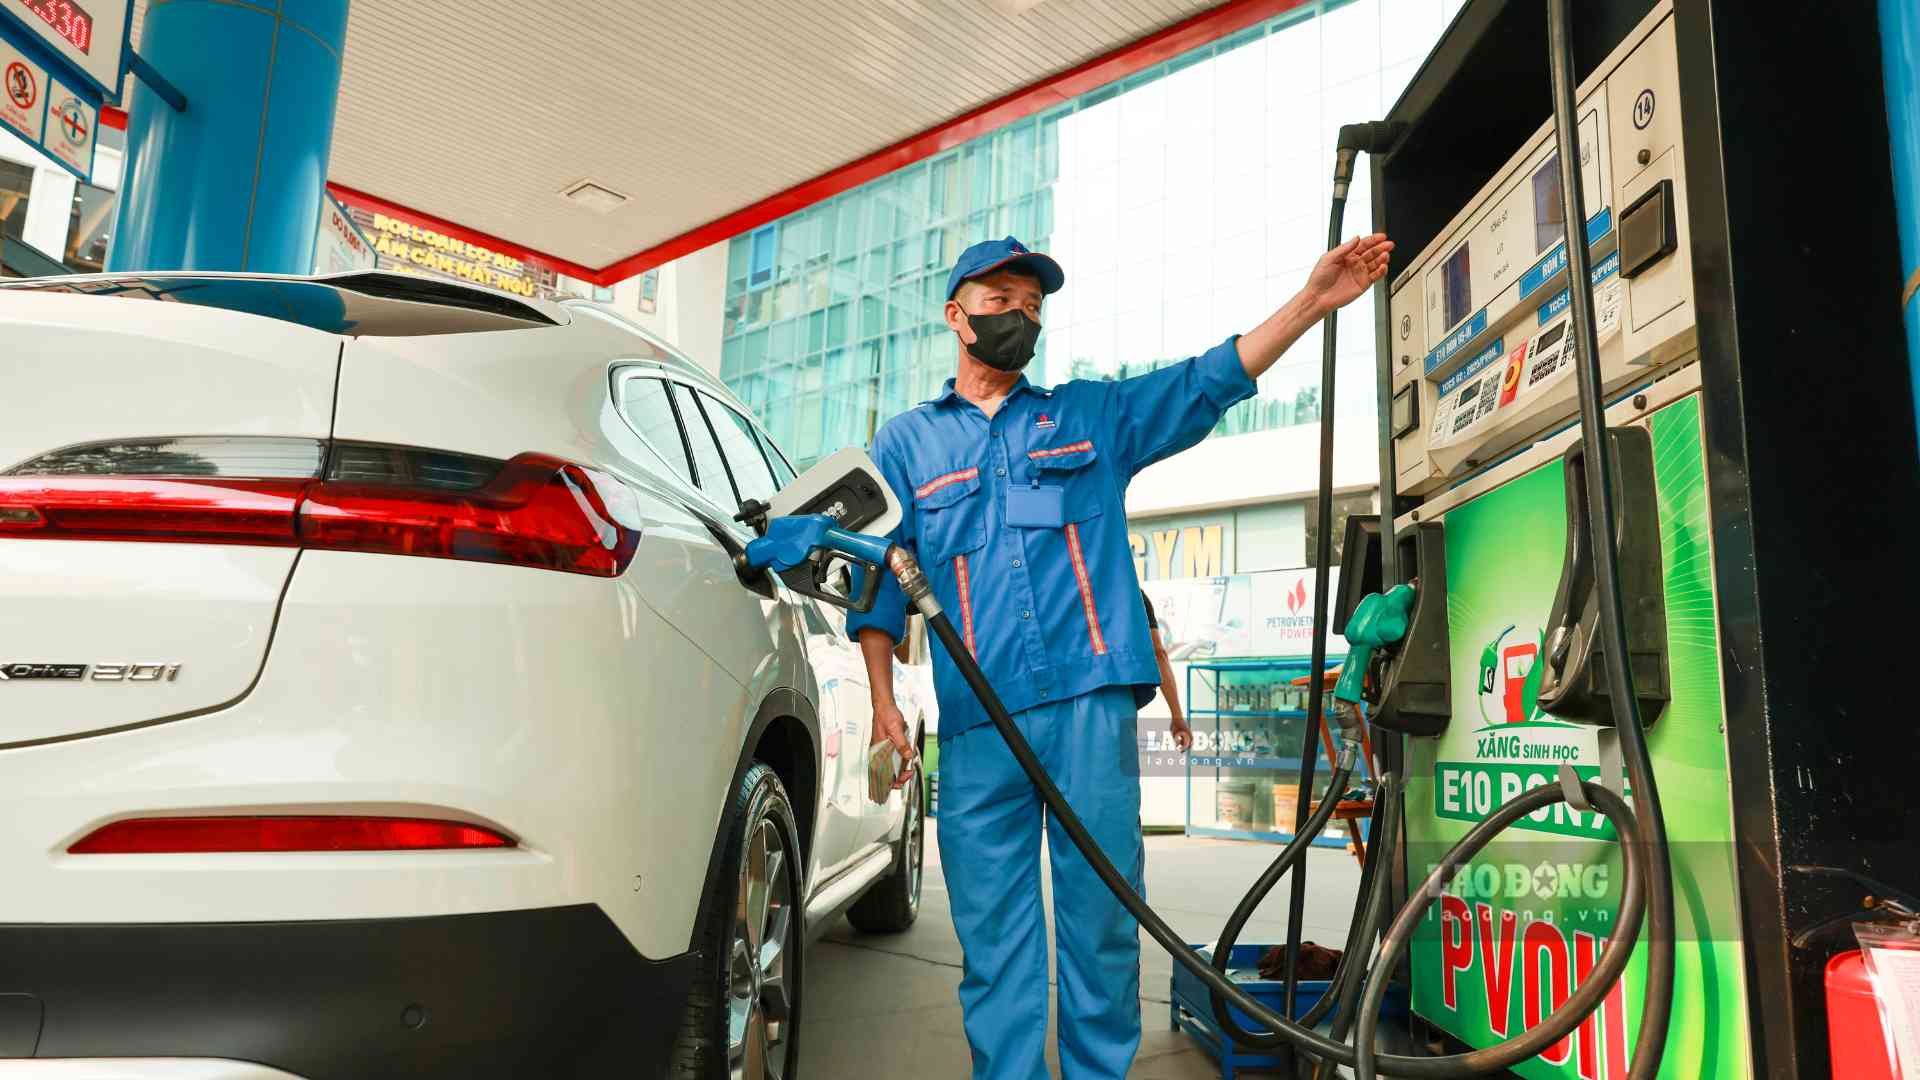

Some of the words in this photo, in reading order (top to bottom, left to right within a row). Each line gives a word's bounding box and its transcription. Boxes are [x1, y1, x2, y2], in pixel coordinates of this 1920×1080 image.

[1637, 95, 1651, 122] 14
[1128, 525, 1223, 581] GYM
[1265, 615, 1314, 627] PETROVIETN
[91, 663, 181, 682] 20i
[1476, 731, 1521, 759] XĂNG
[1523, 743, 1549, 760] SINH
[1443, 768, 1492, 816] E10
